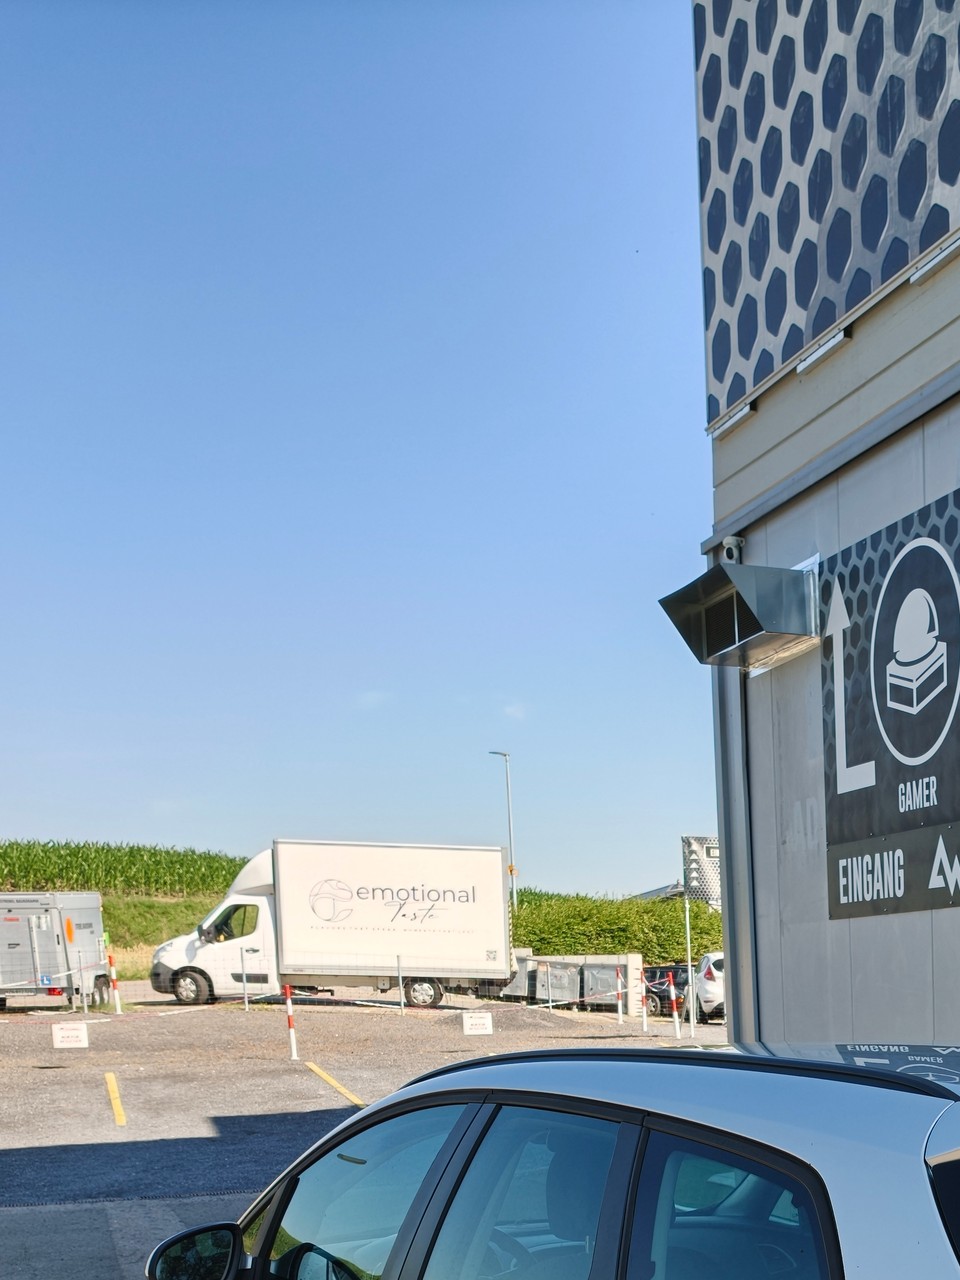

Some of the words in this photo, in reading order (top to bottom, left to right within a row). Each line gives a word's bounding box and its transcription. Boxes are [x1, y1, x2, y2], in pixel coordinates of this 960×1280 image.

[898, 776, 938, 813] GAMER
[838, 848, 905, 904] EINGANG
[356, 884, 476, 903] emotional
[384, 900, 448, 924] Taste
